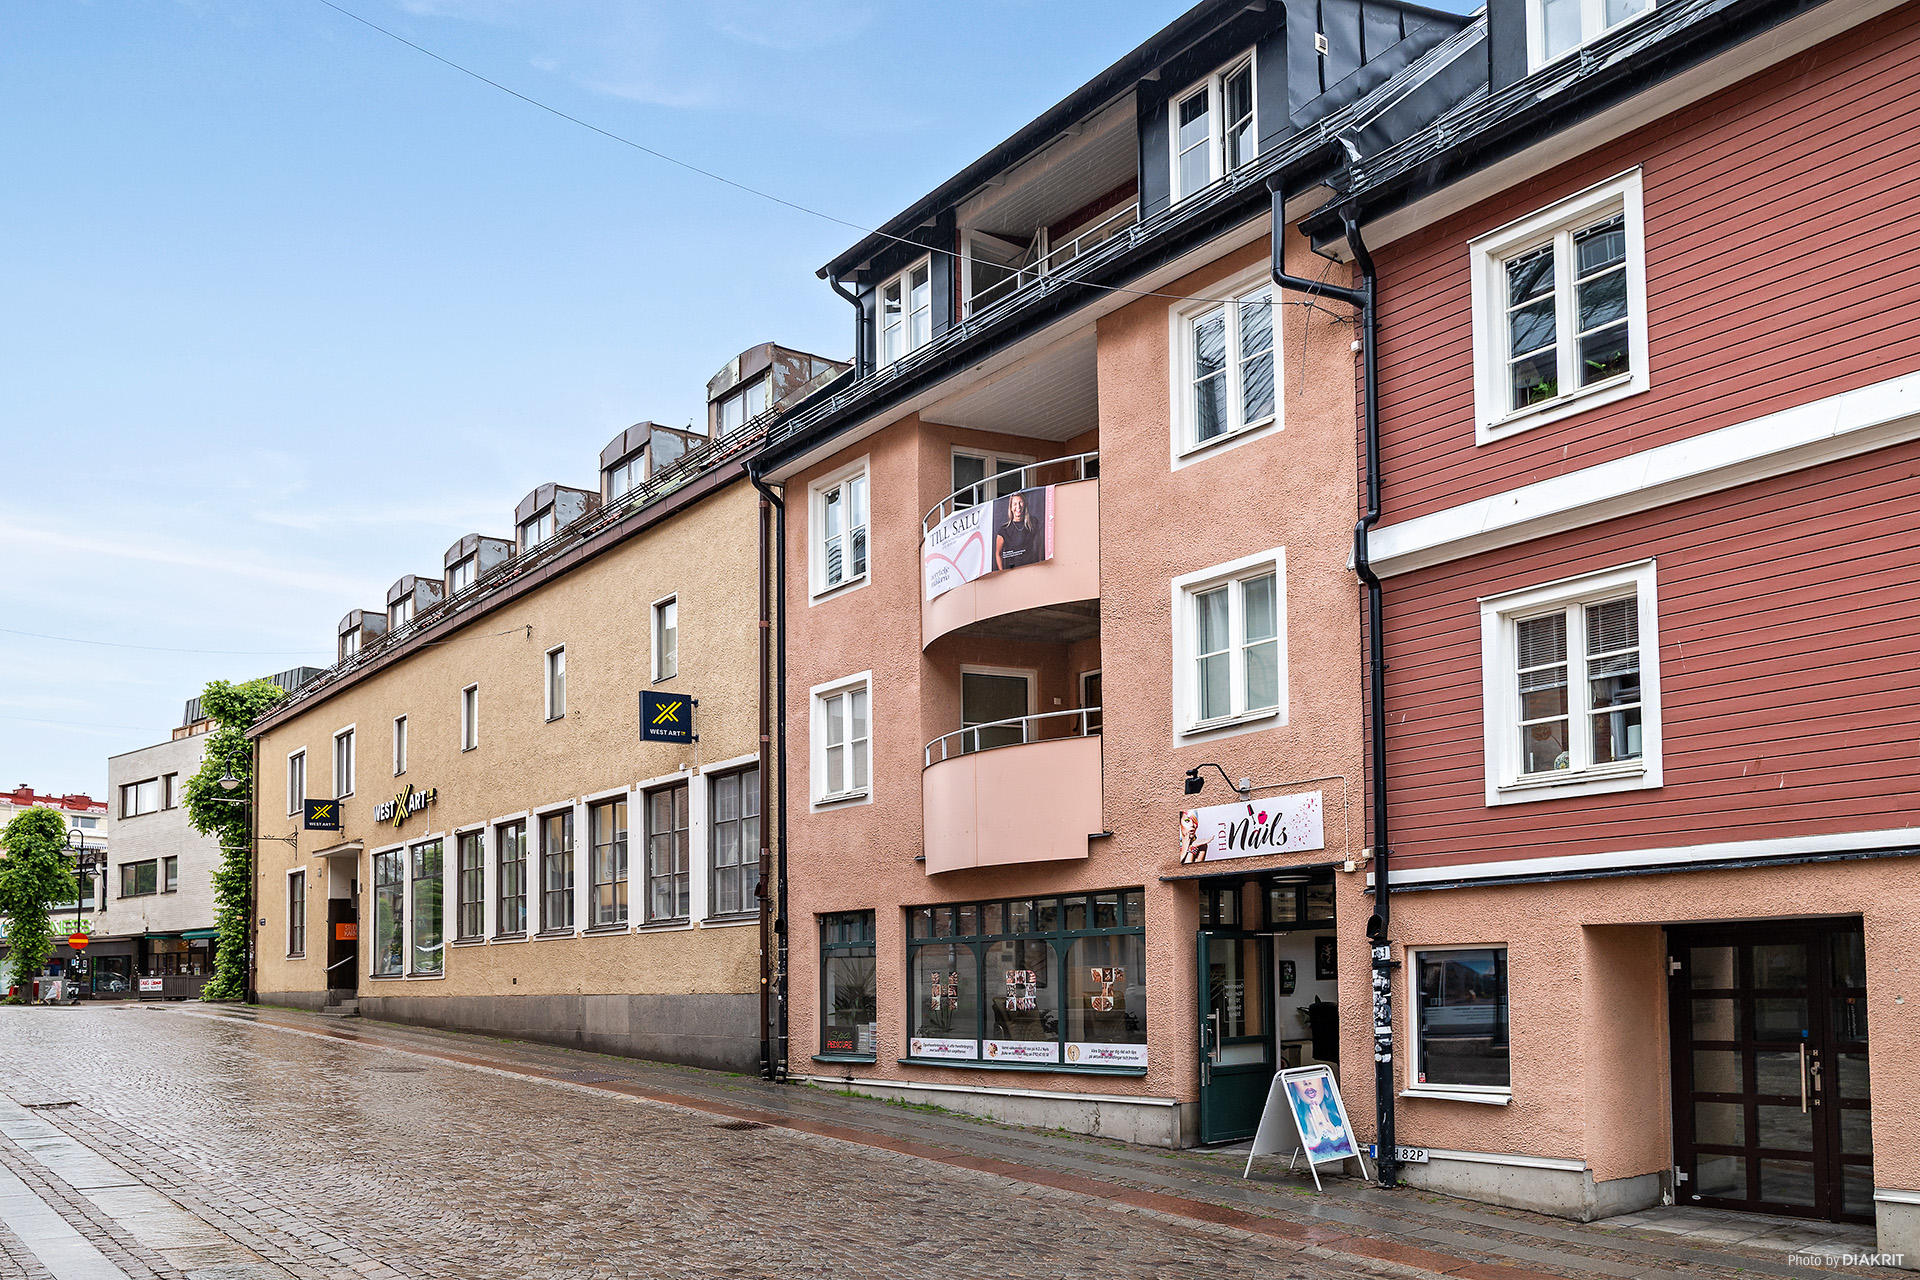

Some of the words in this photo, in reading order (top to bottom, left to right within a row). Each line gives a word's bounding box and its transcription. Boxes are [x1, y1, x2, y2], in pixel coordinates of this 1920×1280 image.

[930, 526, 950, 547] TILL
[952, 510, 980, 536] SALU
[373, 800, 395, 822] WEST
[408, 790, 427, 813] ART
[1228, 812, 1288, 850] Nails
[829, 1030, 851, 1041] Spa
[1402, 1148, 1424, 1160] 82P
